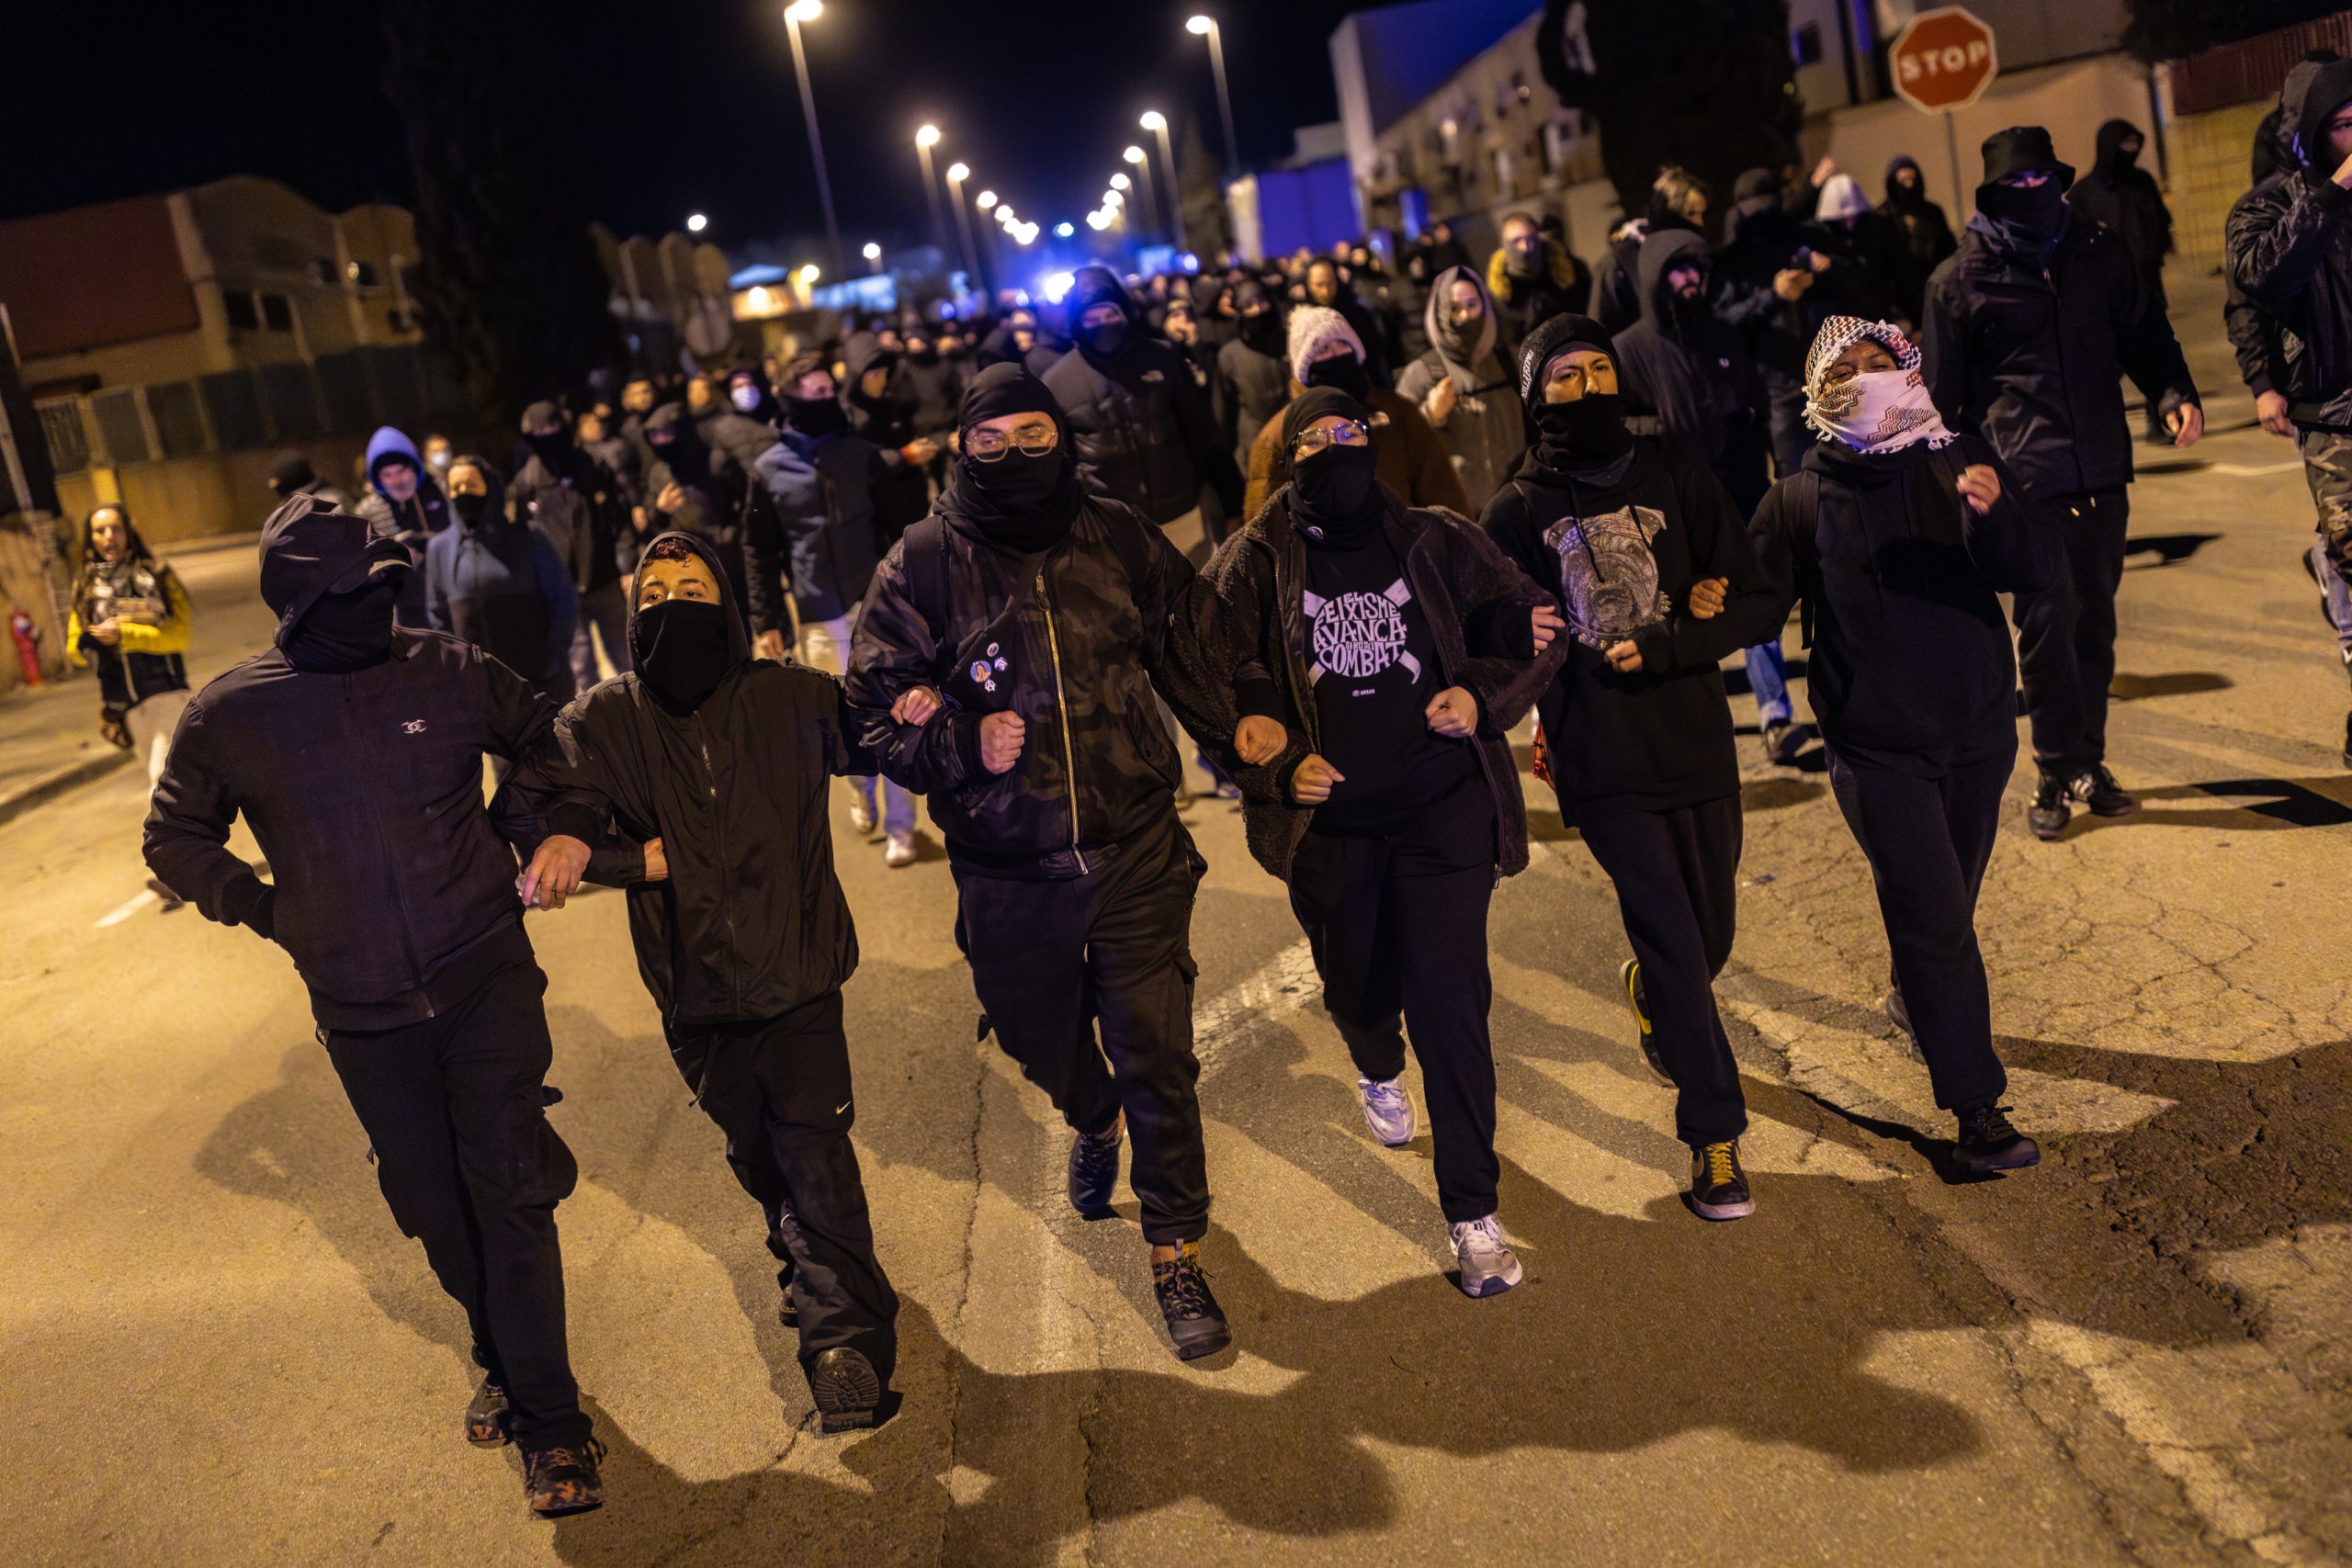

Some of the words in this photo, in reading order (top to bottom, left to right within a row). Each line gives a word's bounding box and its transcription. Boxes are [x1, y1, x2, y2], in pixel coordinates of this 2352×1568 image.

[1900, 40, 1986, 82] STOP
[1315, 592, 1401, 631] FEIXISME
[1343, 592, 1363, 604] EL
[1319, 641, 1406, 677] COMBAT
